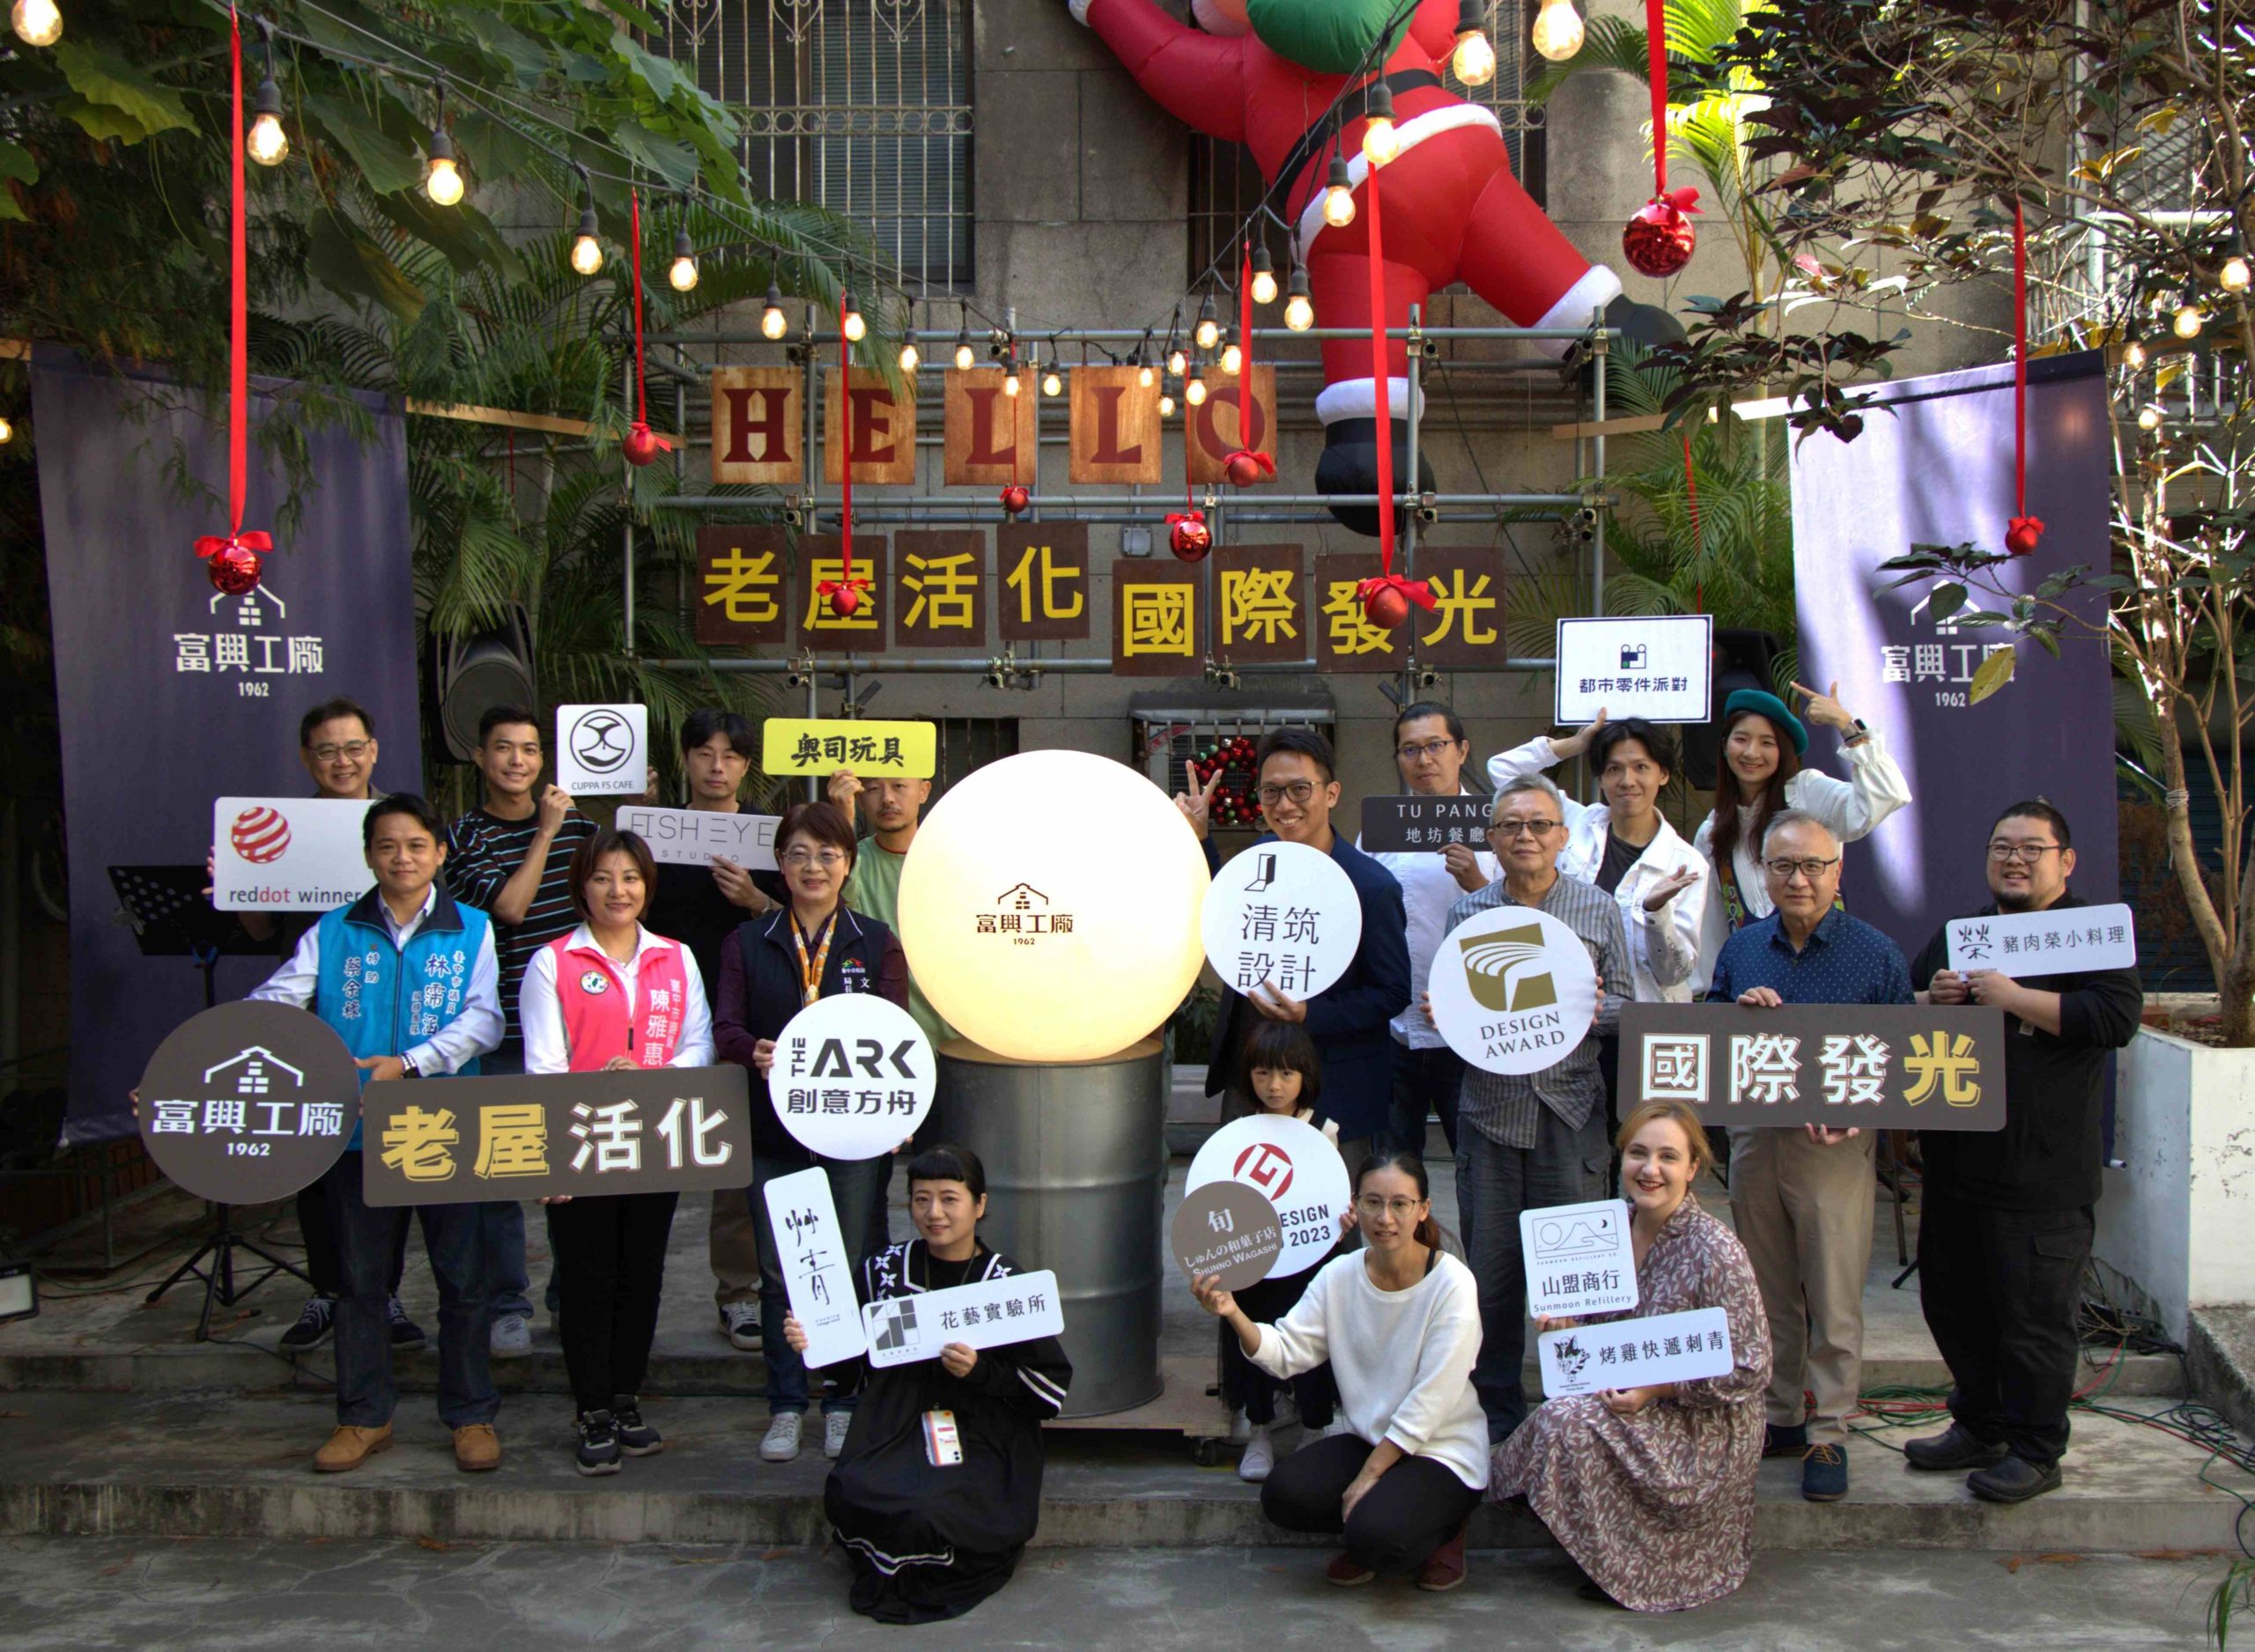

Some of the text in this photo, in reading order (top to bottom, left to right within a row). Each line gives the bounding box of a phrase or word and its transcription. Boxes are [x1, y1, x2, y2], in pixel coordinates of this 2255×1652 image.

[722, 387, 1265, 464] HELLO
[703, 546, 1084, 631] 老屋活化
[174, 633, 323, 674] 富興工廠
[1881, 644, 2015, 682] 富興工
[238, 682, 270, 697] 1962
[1578, 676, 1688, 693] 都市零件派對
[1935, 692, 1966, 707] 1962
[571, 780, 633, 791] CUPPA FS CAFE
[1396, 803, 1493, 818] TU PANG
[631, 813, 773, 846] FISH EYE
[1405, 826, 1486, 844] 地坊餐廳
[662, 849, 739, 862] STUDO
[229, 886, 362, 903] reddot winner
[976, 914, 1073, 933] 富興工廠
[1241, 903, 1321, 944] 清筑
[2002, 926, 2126, 954] 豬肉榮小料理
[1238, 951, 1317, 992] 設計
[643, 989, 670, 1066] 陳雅惠
[1480, 1011, 1561, 1040] DESIGN
[791, 1037, 806, 1077] THE
[1485, 1030, 1565, 1058] AWARD
[810, 1038, 917, 1079] ARK
[1640, 1030, 1982, 1107] 國際發光
[787, 1088, 917, 1116] 創意方舟
[152, 1099, 344, 1137] 富興工廠
[226, 1142, 270, 1156] 1962
[381, 1097, 732, 1181] 老屋活化
[1208, 1207, 1234, 1233] 旬
[1279, 1204, 1330, 1228] ESIGN
[1290, 1225, 1331, 1248] 2023
[1542, 1270, 1621, 1297] 山盟商行
[939, 1294, 1046, 1331] 花藝實驗所
[1534, 1294, 1632, 1312] Sunmoon Refillery
[1599, 1331, 1725, 1365] 烤雞快遞刺青
